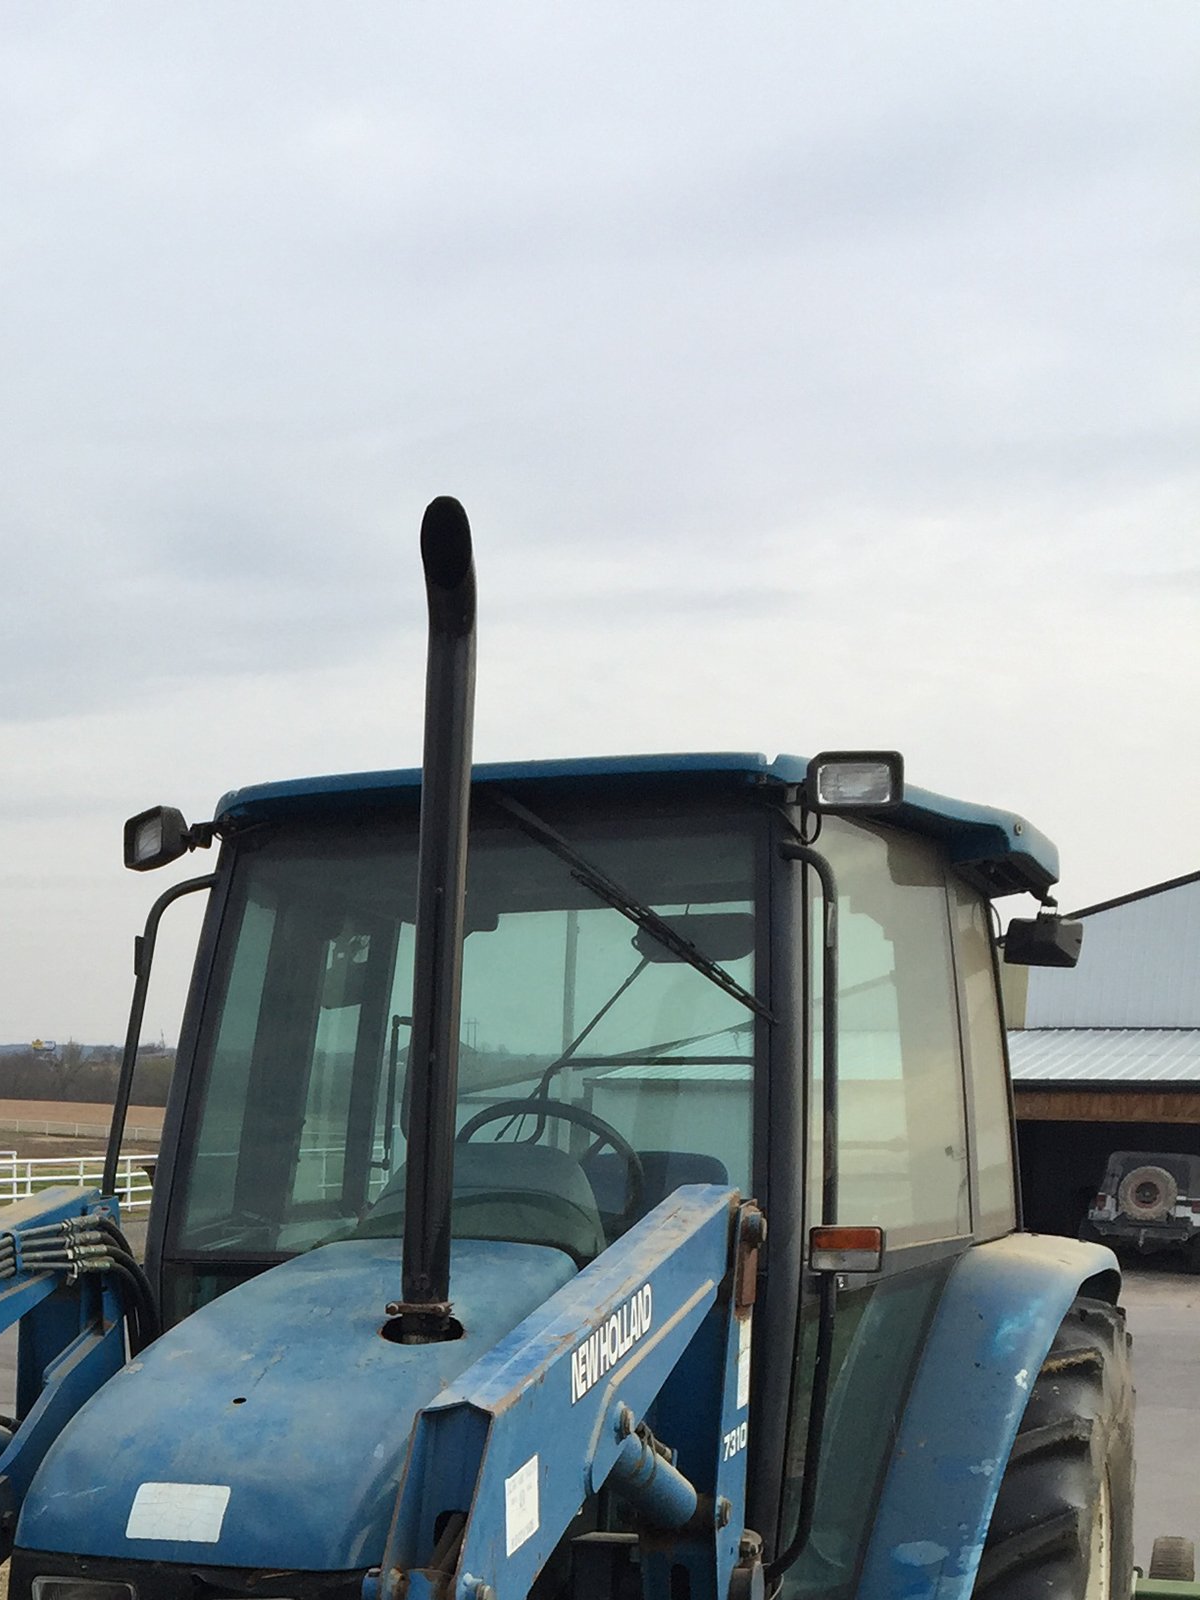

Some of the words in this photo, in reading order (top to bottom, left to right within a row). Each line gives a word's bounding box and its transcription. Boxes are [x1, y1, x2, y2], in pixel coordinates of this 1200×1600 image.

[571, 1330, 599, 1405] NEW
[599, 1282, 652, 1377] HOLLAND
[723, 1421, 748, 1462] 7310
